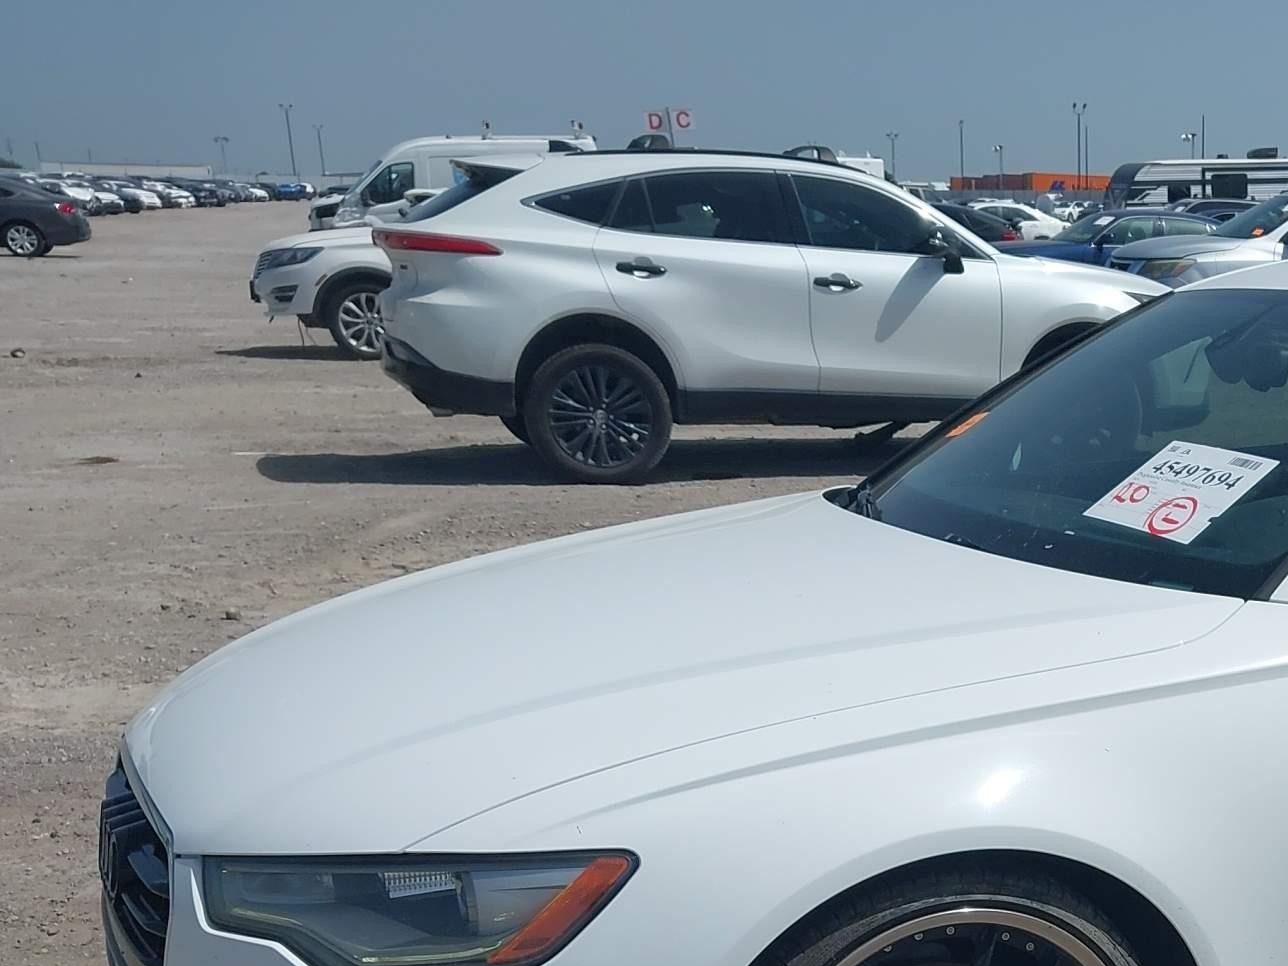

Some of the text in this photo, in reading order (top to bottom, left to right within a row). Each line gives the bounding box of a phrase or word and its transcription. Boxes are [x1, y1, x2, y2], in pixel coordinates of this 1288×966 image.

[648, 113, 662, 130] D
[676, 111, 691, 128] C
[1151, 460, 1244, 490] 45497694
